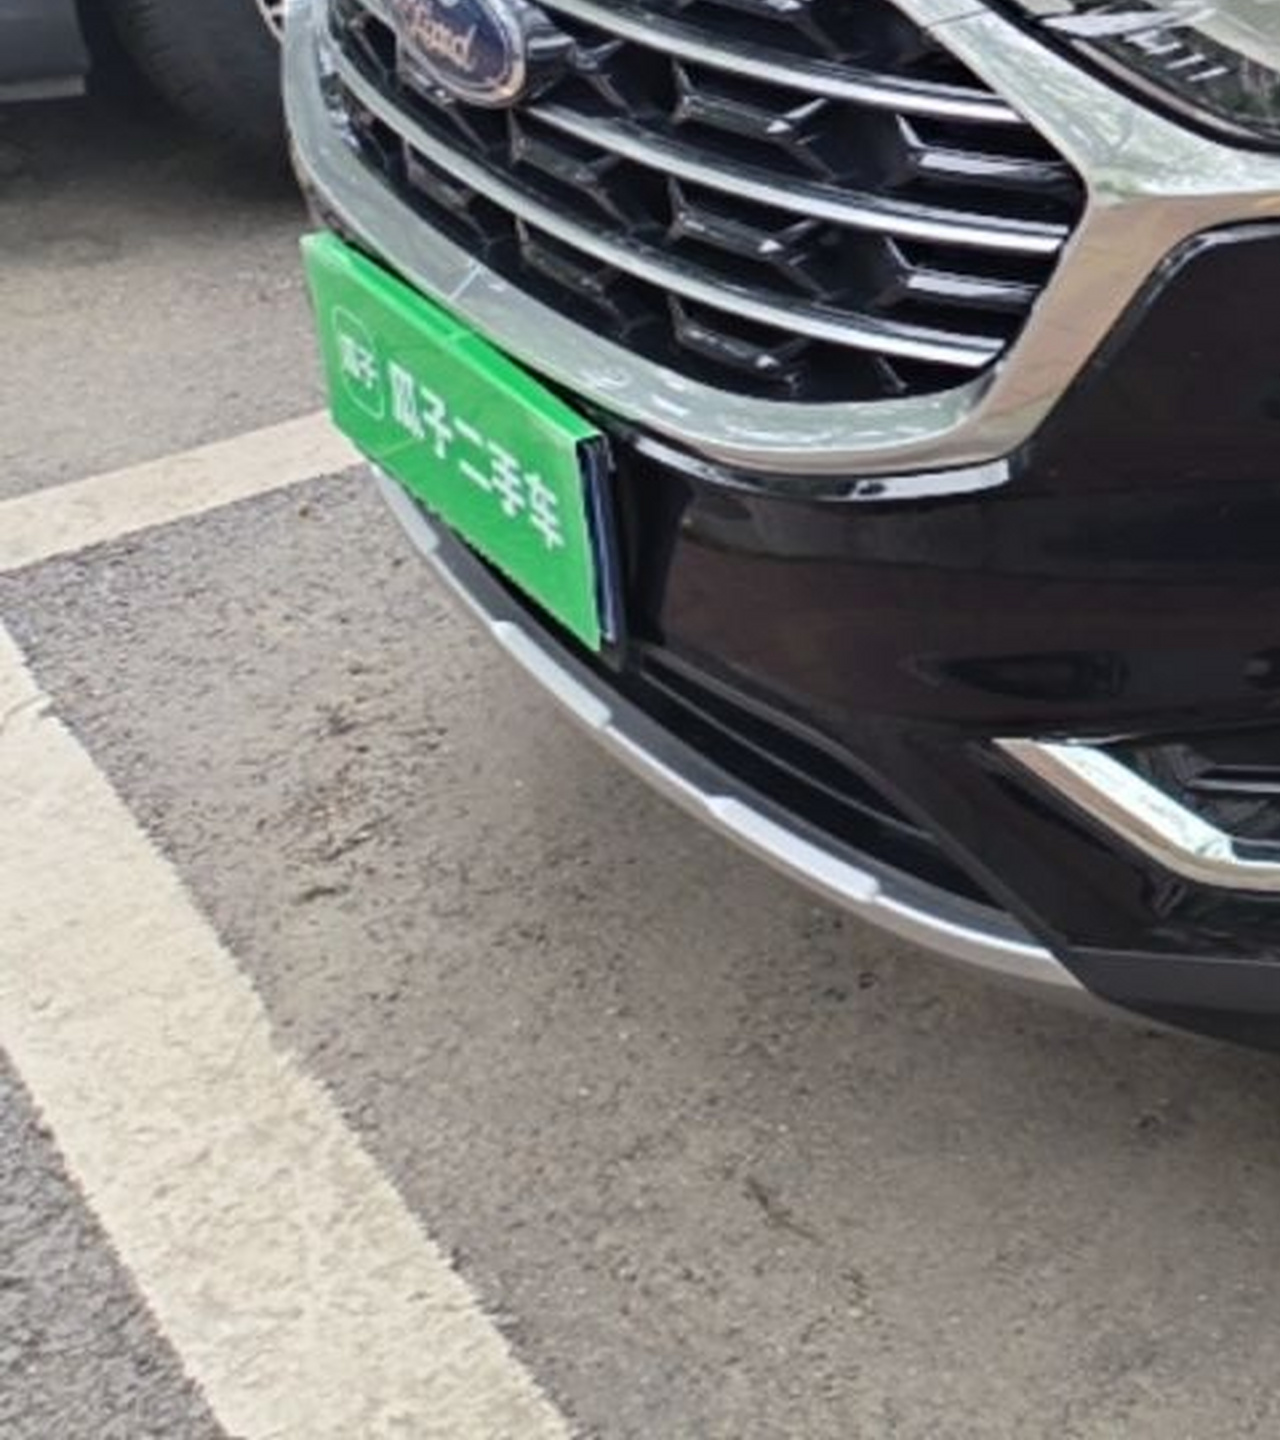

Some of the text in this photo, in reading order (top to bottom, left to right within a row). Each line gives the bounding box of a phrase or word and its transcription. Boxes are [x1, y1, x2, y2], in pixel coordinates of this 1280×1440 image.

[387, 358, 564, 550] 瓜子二手车
